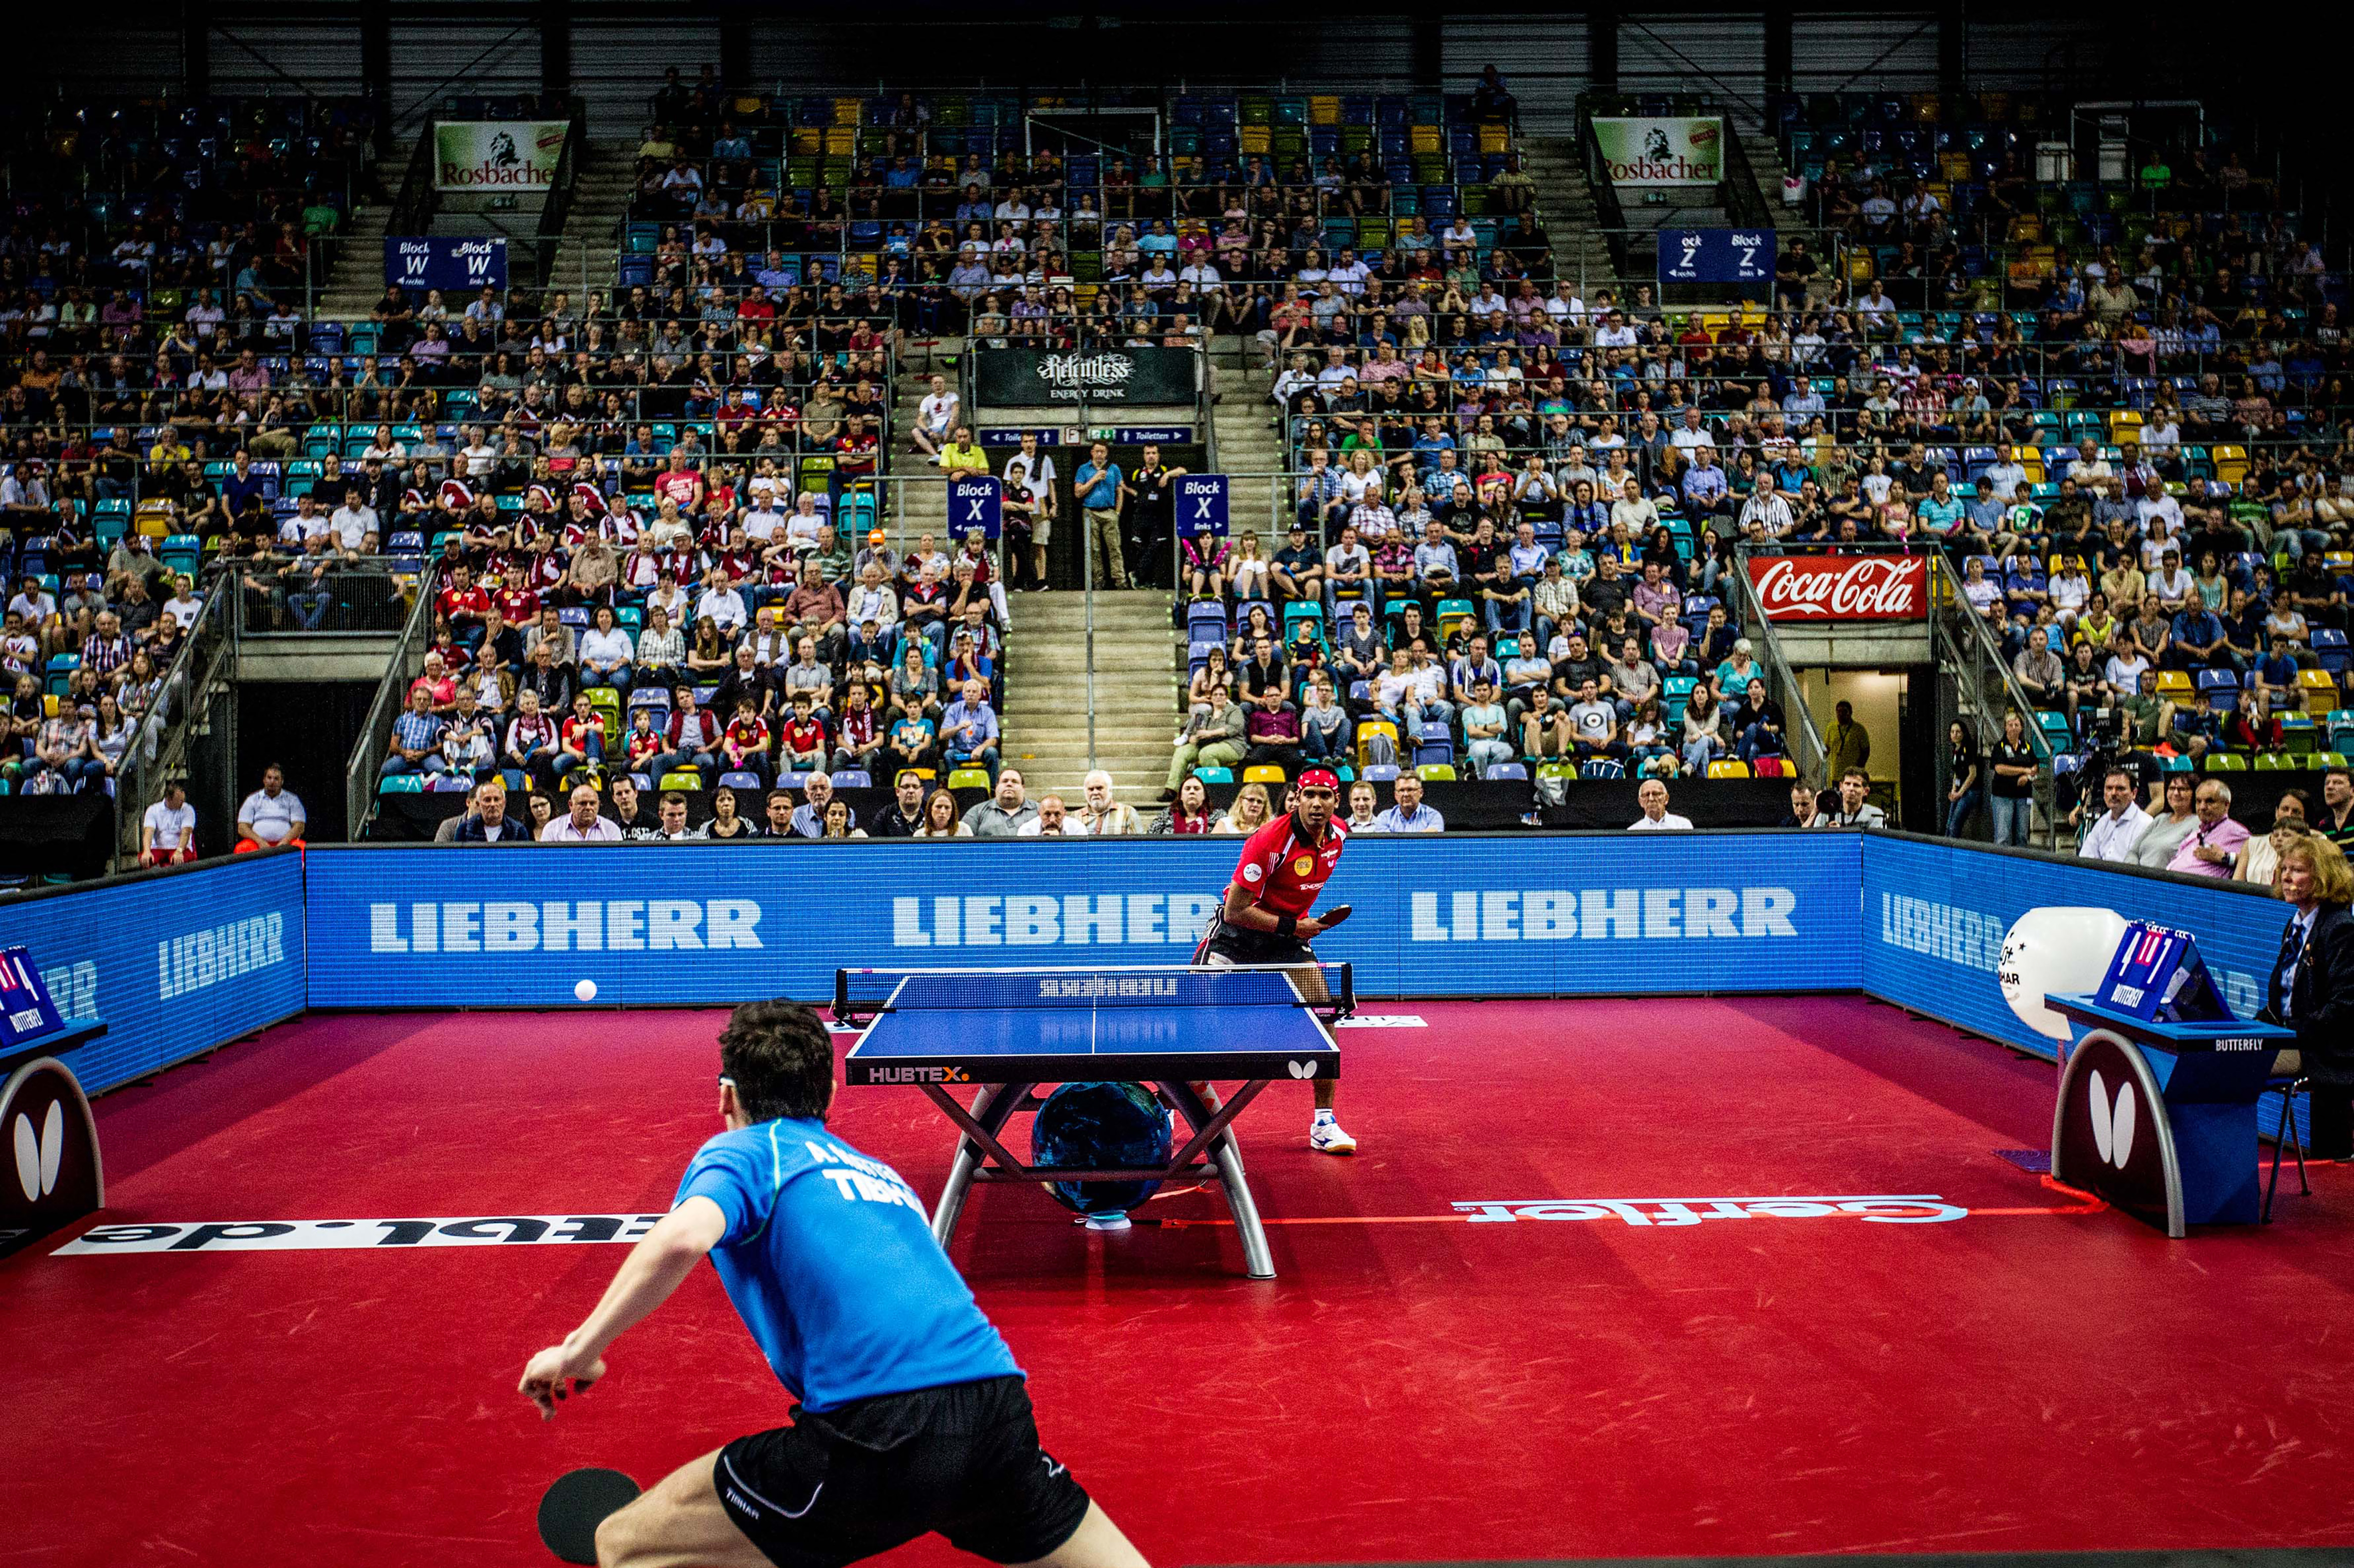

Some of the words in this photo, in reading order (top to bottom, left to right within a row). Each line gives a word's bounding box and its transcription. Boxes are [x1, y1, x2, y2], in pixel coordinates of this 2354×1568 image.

[442, 160, 555, 185] Rosbache
[399, 242, 430, 254] Block
[461, 242, 493, 254] Block
[1732, 234, 1762, 246] Block
[406, 256, 429, 275] W
[468, 256, 491, 275] W
[1680, 249, 1696, 267] Z
[1740, 248, 1755, 267] Z
[1093, 389, 1125, 399] DRINK
[1135, 432, 1169, 440] Toiletten
[957, 484, 992, 496] Block
[1185, 482, 1220, 494] Block
[967, 499, 984, 521] X
[1195, 497, 1213, 519] X
[1194, 522, 1211, 531] links
[1756, 557, 1922, 615] Coca-Cola
[893, 893, 1225, 946] LIEBHER
[1411, 886, 1798, 941] LIEBHERR
[371, 899, 764, 953] LIEBHERR
[1882, 891, 2004, 973] LIEBHERR
[160, 911, 284, 1001] LIEBHERR
[2119, 930, 2142, 976] 4
[2110, 983, 2145, 1009] BUTTERFLY
[9, 1007, 44, 1033] BUTTERFLY
[2215, 1038, 2263, 1051] BUTTERFLY
[1467, 1200, 1968, 1226] Gerflor
[726, 1486, 760, 1520] TIBHAR
